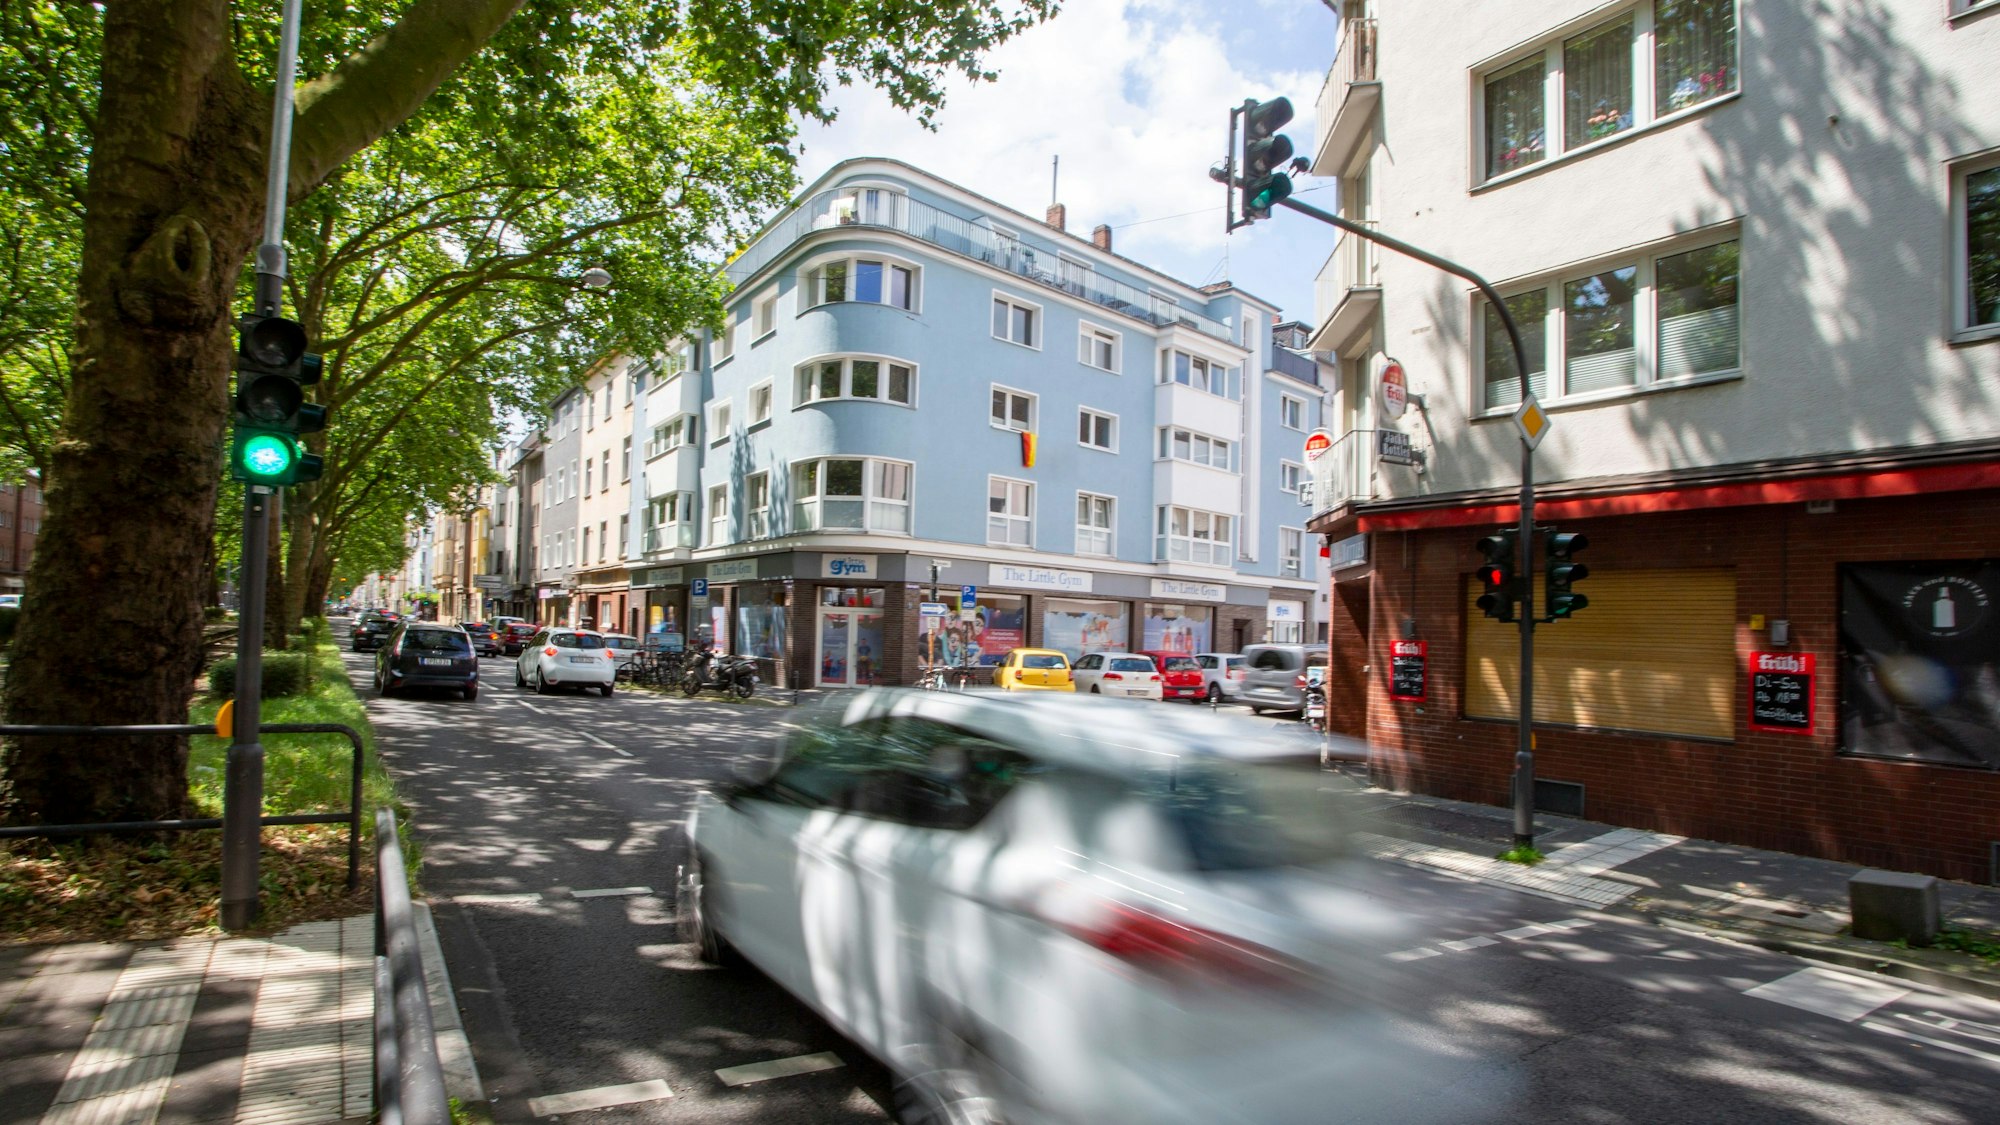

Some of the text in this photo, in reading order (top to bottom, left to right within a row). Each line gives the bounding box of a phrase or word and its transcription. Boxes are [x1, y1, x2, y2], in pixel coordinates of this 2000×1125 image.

[1383, 443, 1411, 458] Bottles
[830, 560, 868, 575] gym
[1003, 567, 1082, 589] The Little Gym
[1160, 581, 1219, 599] The Little Gym
[1757, 654, 1800, 673] früh
